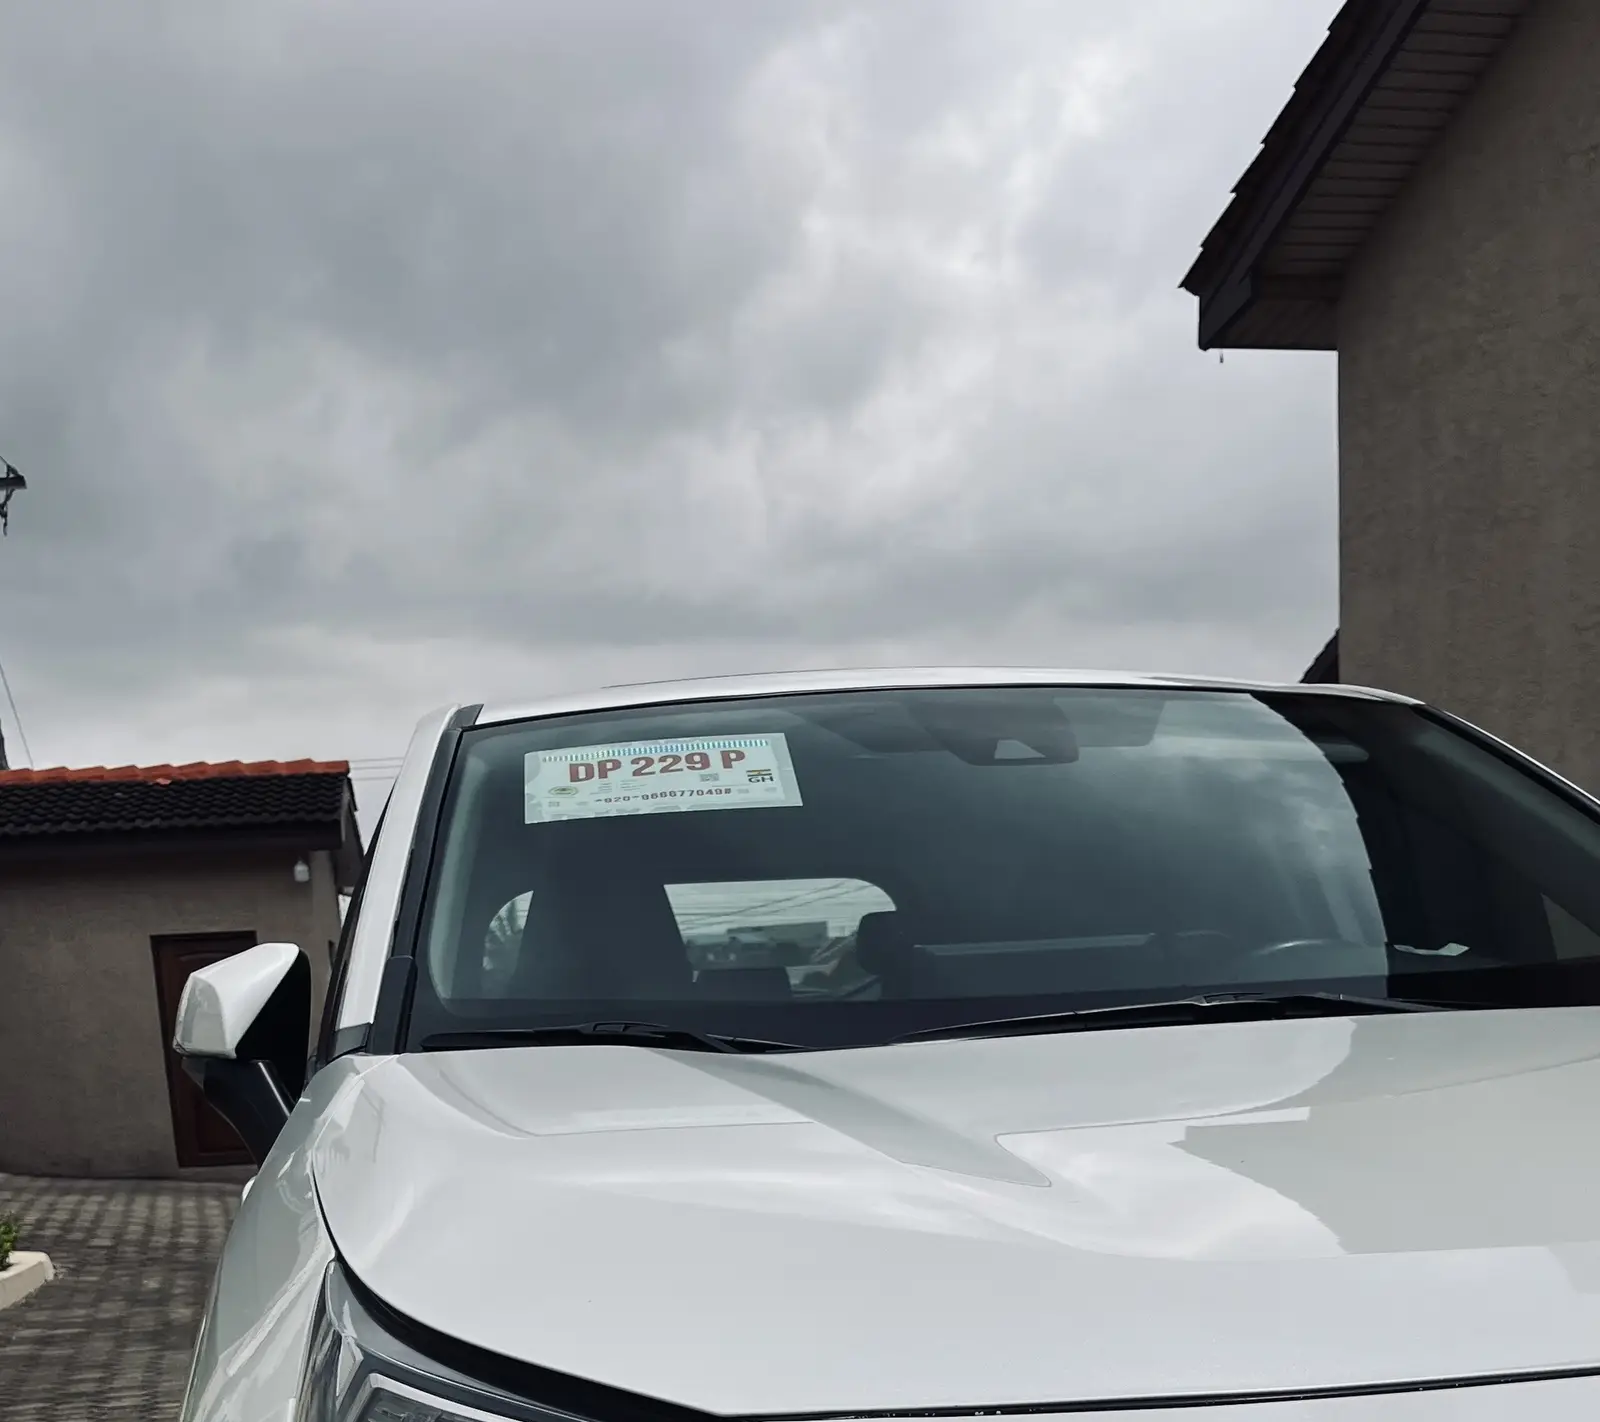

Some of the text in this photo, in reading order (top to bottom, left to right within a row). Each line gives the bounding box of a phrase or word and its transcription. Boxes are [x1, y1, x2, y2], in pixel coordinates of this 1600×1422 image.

[569, 749, 746, 783] DP 229 P
[748, 775, 774, 784] GH
